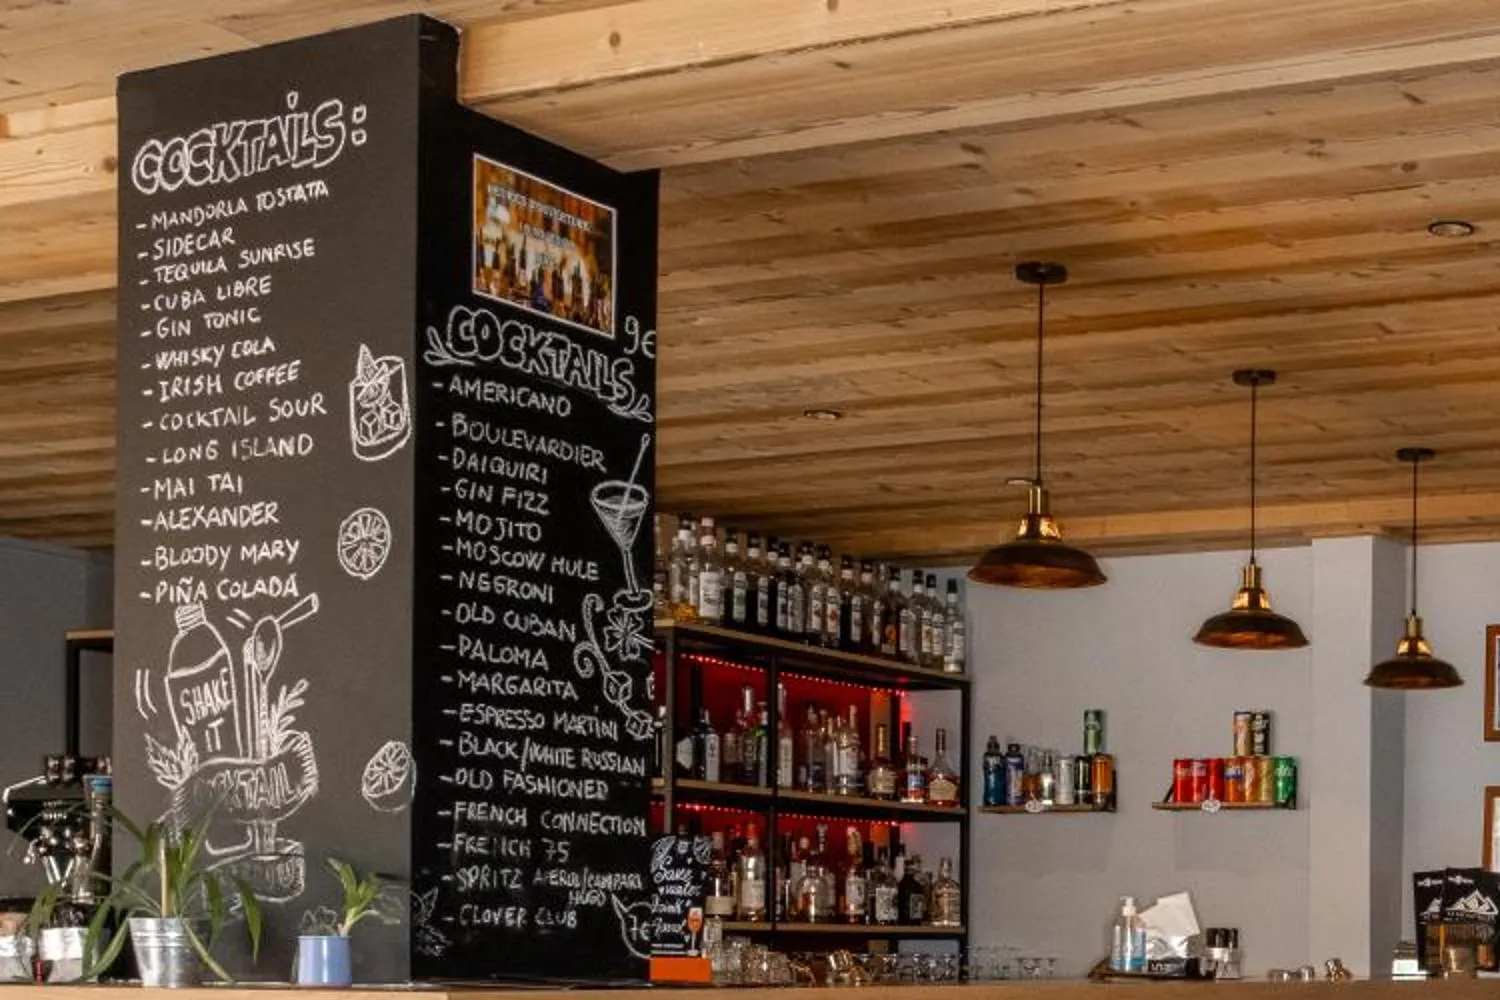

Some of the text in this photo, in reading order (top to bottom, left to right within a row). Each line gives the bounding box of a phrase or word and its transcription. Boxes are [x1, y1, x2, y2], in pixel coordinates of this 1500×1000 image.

[151, 179, 329, 231] MANDORLA TOSTATA
[153, 228, 236, 261] SIDECAR
[153, 238, 316, 284] TEQUILA SUNRISE
[153, 275, 273, 312] CUBA LIBRE
[156, 307, 261, 339] GIN TONIC
[155, 336, 276, 371] WHISKY COLA
[446, 305, 636, 408] COCKTAILS
[160, 360, 301, 402] IRISH COFFEE
[449, 375, 571, 417] AMERICANO
[160, 392, 327, 431] COCKTAIL SOUR
[163, 433, 313, 465] LONG ISLAND
[452, 412, 608, 473] BOULEVARDIER
[452, 448, 547, 485] DAIQUIRI
[154, 472, 243, 500] MAI TAI
[454, 478, 550, 516] GIN FIZZ
[154, 501, 280, 532] ALEXANDER
[455, 508, 542, 542] MOJITO
[155, 538, 300, 571] BLOODY MARY
[456, 536, 546, 571] MOSCOW
[155, 572, 301, 604] PIÑA COLADA
[458, 570, 553, 604] NEGRONI
[455, 602, 576, 643] OLD CUBAN
[458, 634, 549, 671] PALOMA
[180, 667, 233, 725] SHAKE
[457, 669, 579, 701] MARGARITA
[205, 718, 225, 752] IT
[459, 703, 619, 742] ESPRESSO MARTINI
[581, 748, 645, 776] RUSSIAN
[197, 762, 296, 810] KTAIL
[455, 768, 609, 800] OLD FASHIONED
[454, 801, 646, 837] FRENCH CONNECTION
[454, 835, 570, 863] FRENCH 75
[456, 866, 523, 893] SPRITZ
[459, 904, 577, 929] CLOVER CLUB
